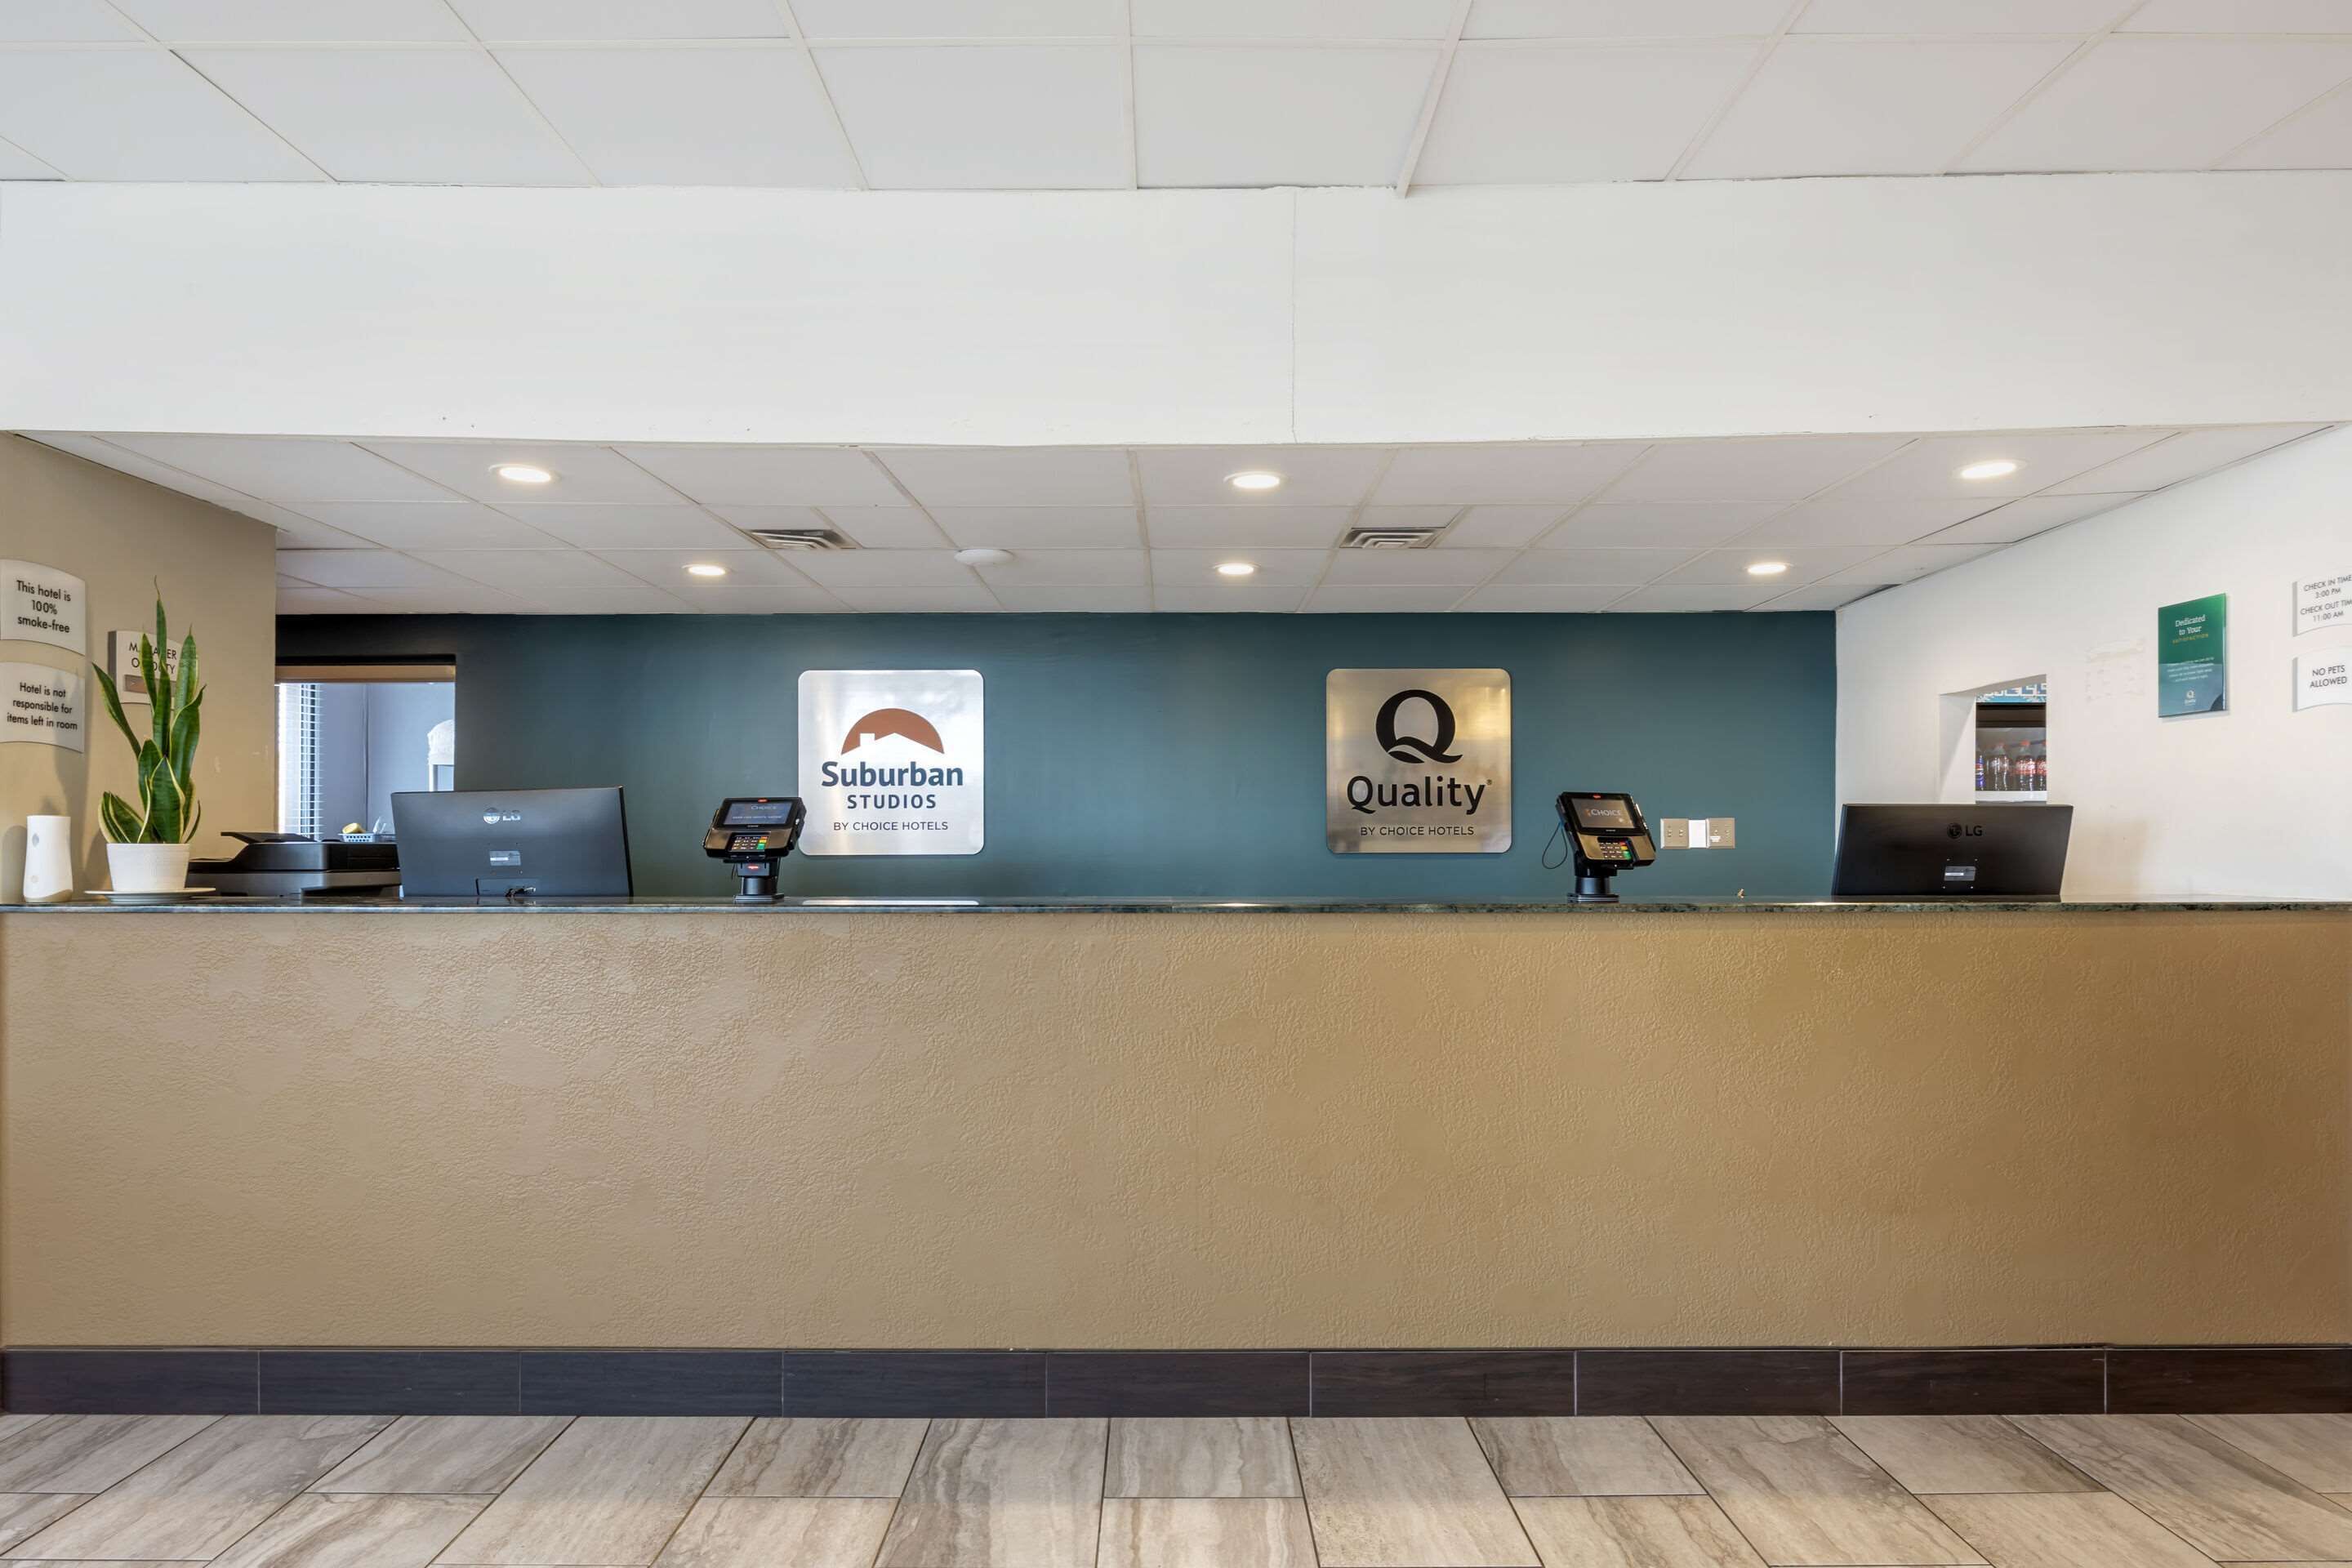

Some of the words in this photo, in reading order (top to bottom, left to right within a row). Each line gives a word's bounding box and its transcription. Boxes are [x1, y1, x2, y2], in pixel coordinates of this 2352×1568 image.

[2304, 581, 2326, 591] CHECK
[2337, 574, 2352, 583] TIME
[16, 580, 35, 595] This
[38, 584, 61, 599] hotel
[64, 590, 71, 602] is
[32, 599, 58, 615] 100%
[2300, 604, 2323, 615] CHECK
[2324, 600, 2339, 610] OUT
[2176, 614, 2206, 627] Dedicated
[2313, 612, 2332, 621] 11:00
[17, 617, 70, 633] smoke-free
[129, 642, 177, 660] MAER
[2312, 667, 2326, 676] NO
[2328, 665, 2345, 675] PETS
[2310, 676, 2347, 688] ALLOWED
[20, 682, 42, 695] Hotel
[44, 685, 51, 696] is
[52, 689, 66, 698] not
[12, 700, 59, 713] responsible
[60, 703, 73, 714] for
[7, 712, 29, 725] items
[31, 715, 44, 726] left
[46, 717, 54, 727] in
[56, 720, 78, 730] room
[821, 761, 964, 787] Suburban
[847, 794, 937, 809] STUDIOS
[1347, 776, 1486, 815] Quality
[833, 822, 849, 831] BY
[853, 822, 898, 831] CHOICE
[902, 822, 948, 831] HOTELS
[1361, 826, 1376, 835] BY
[1379, 826, 1424, 836] CHOICE
[1428, 826, 1474, 836] HOTELS
[1965, 825, 1983, 837] LG
